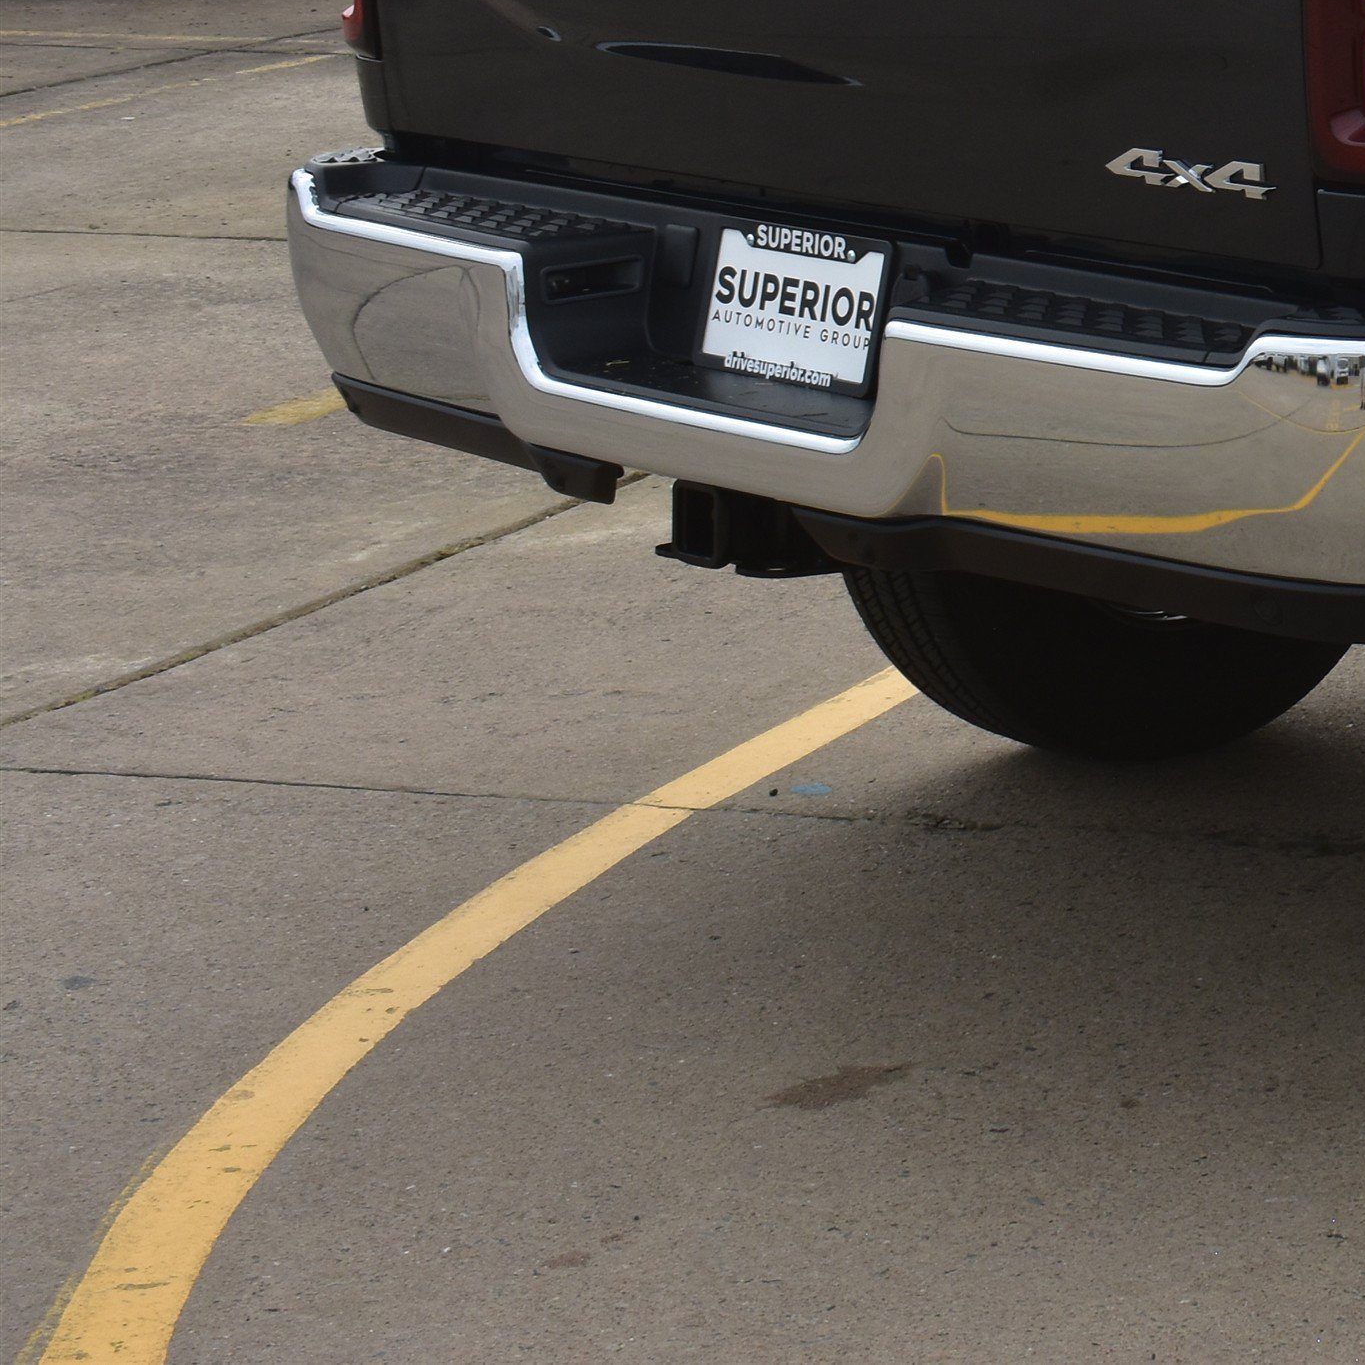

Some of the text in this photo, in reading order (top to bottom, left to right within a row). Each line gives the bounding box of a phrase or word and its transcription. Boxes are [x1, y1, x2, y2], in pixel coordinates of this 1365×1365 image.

[756, 224, 847, 260] SUPERIOR
[715, 266, 875, 332] SUPERIOR
[711, 309, 870, 351] AUTOMOTIVE GROUP
[724, 351, 832, 387] drivesuperior.com
